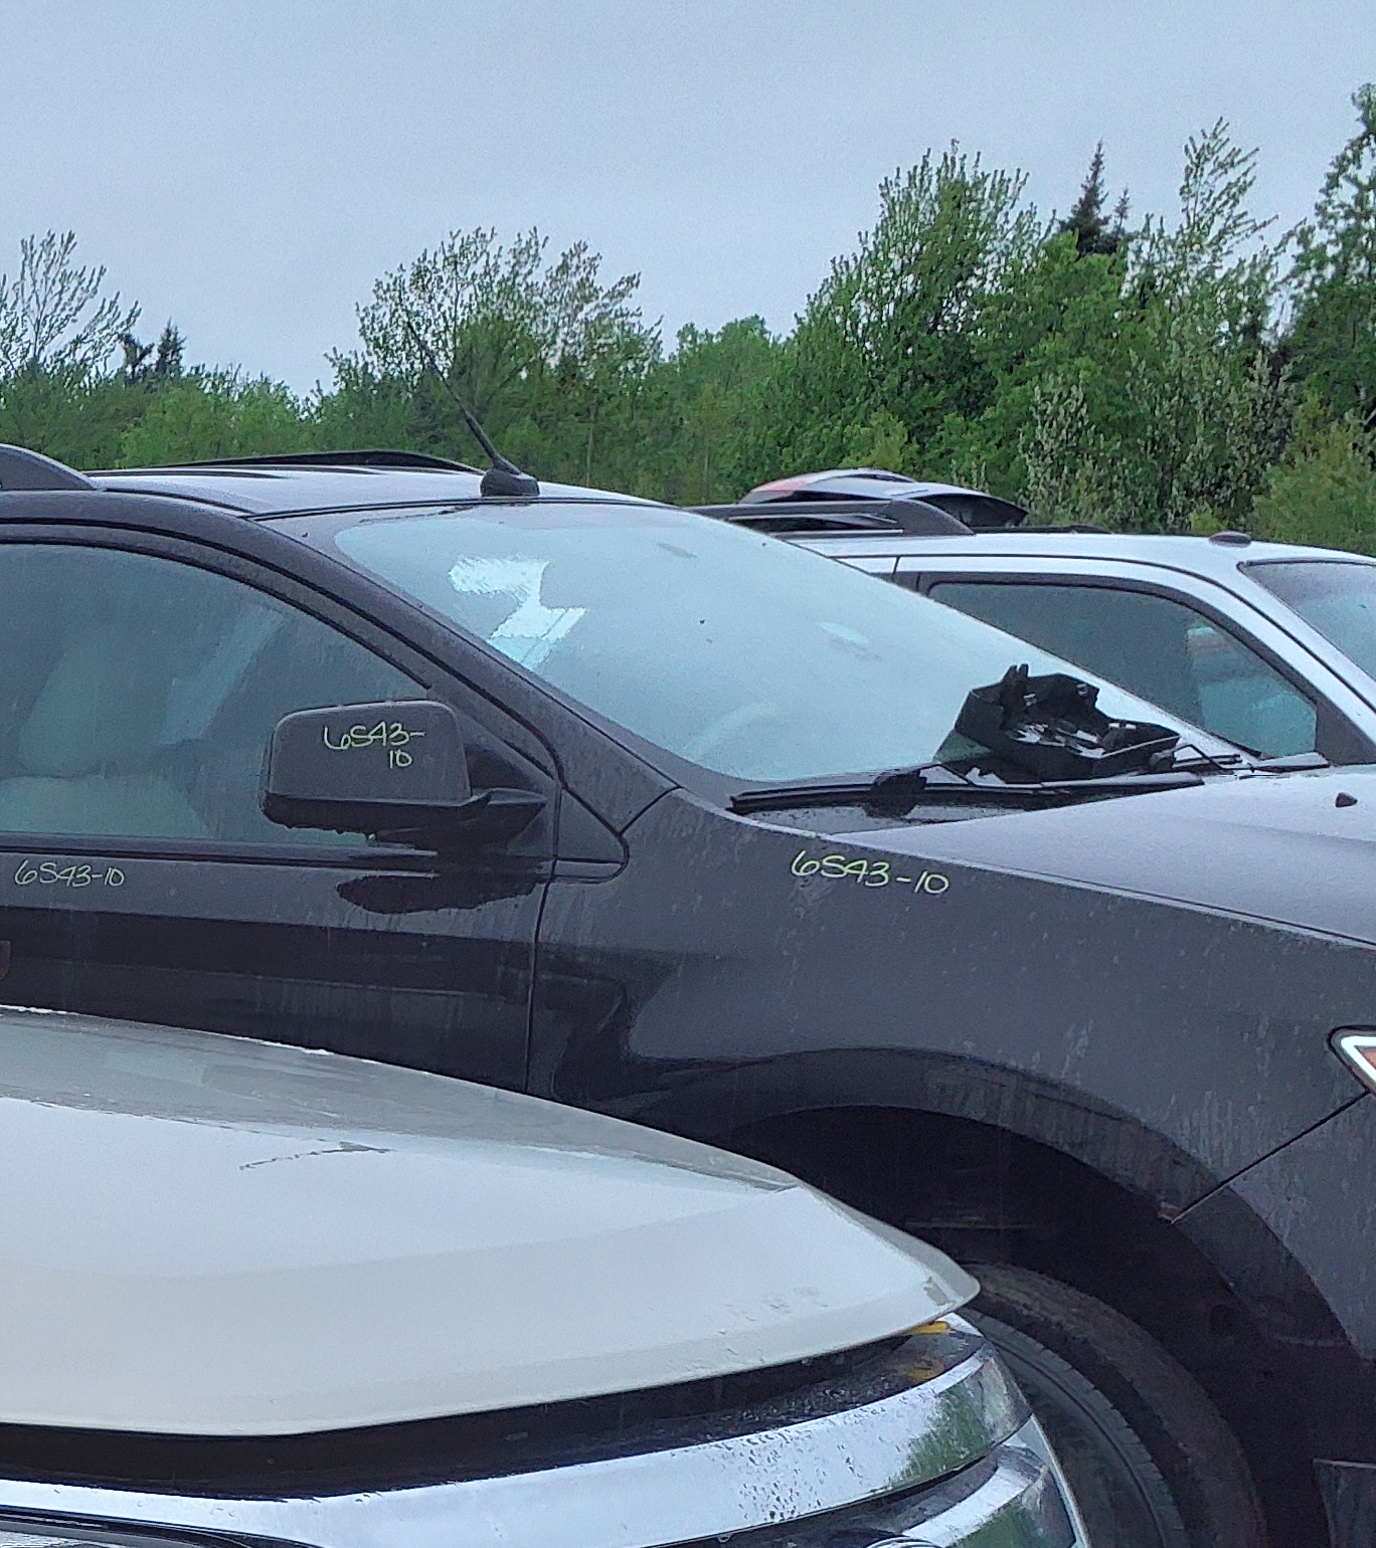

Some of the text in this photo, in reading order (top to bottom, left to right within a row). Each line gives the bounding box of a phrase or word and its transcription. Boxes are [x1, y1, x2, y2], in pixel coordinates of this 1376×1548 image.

[388, 749, 413, 769] 10
[14, 859, 125, 887] 6543-10
[791, 850, 950, 894] 6543-10
